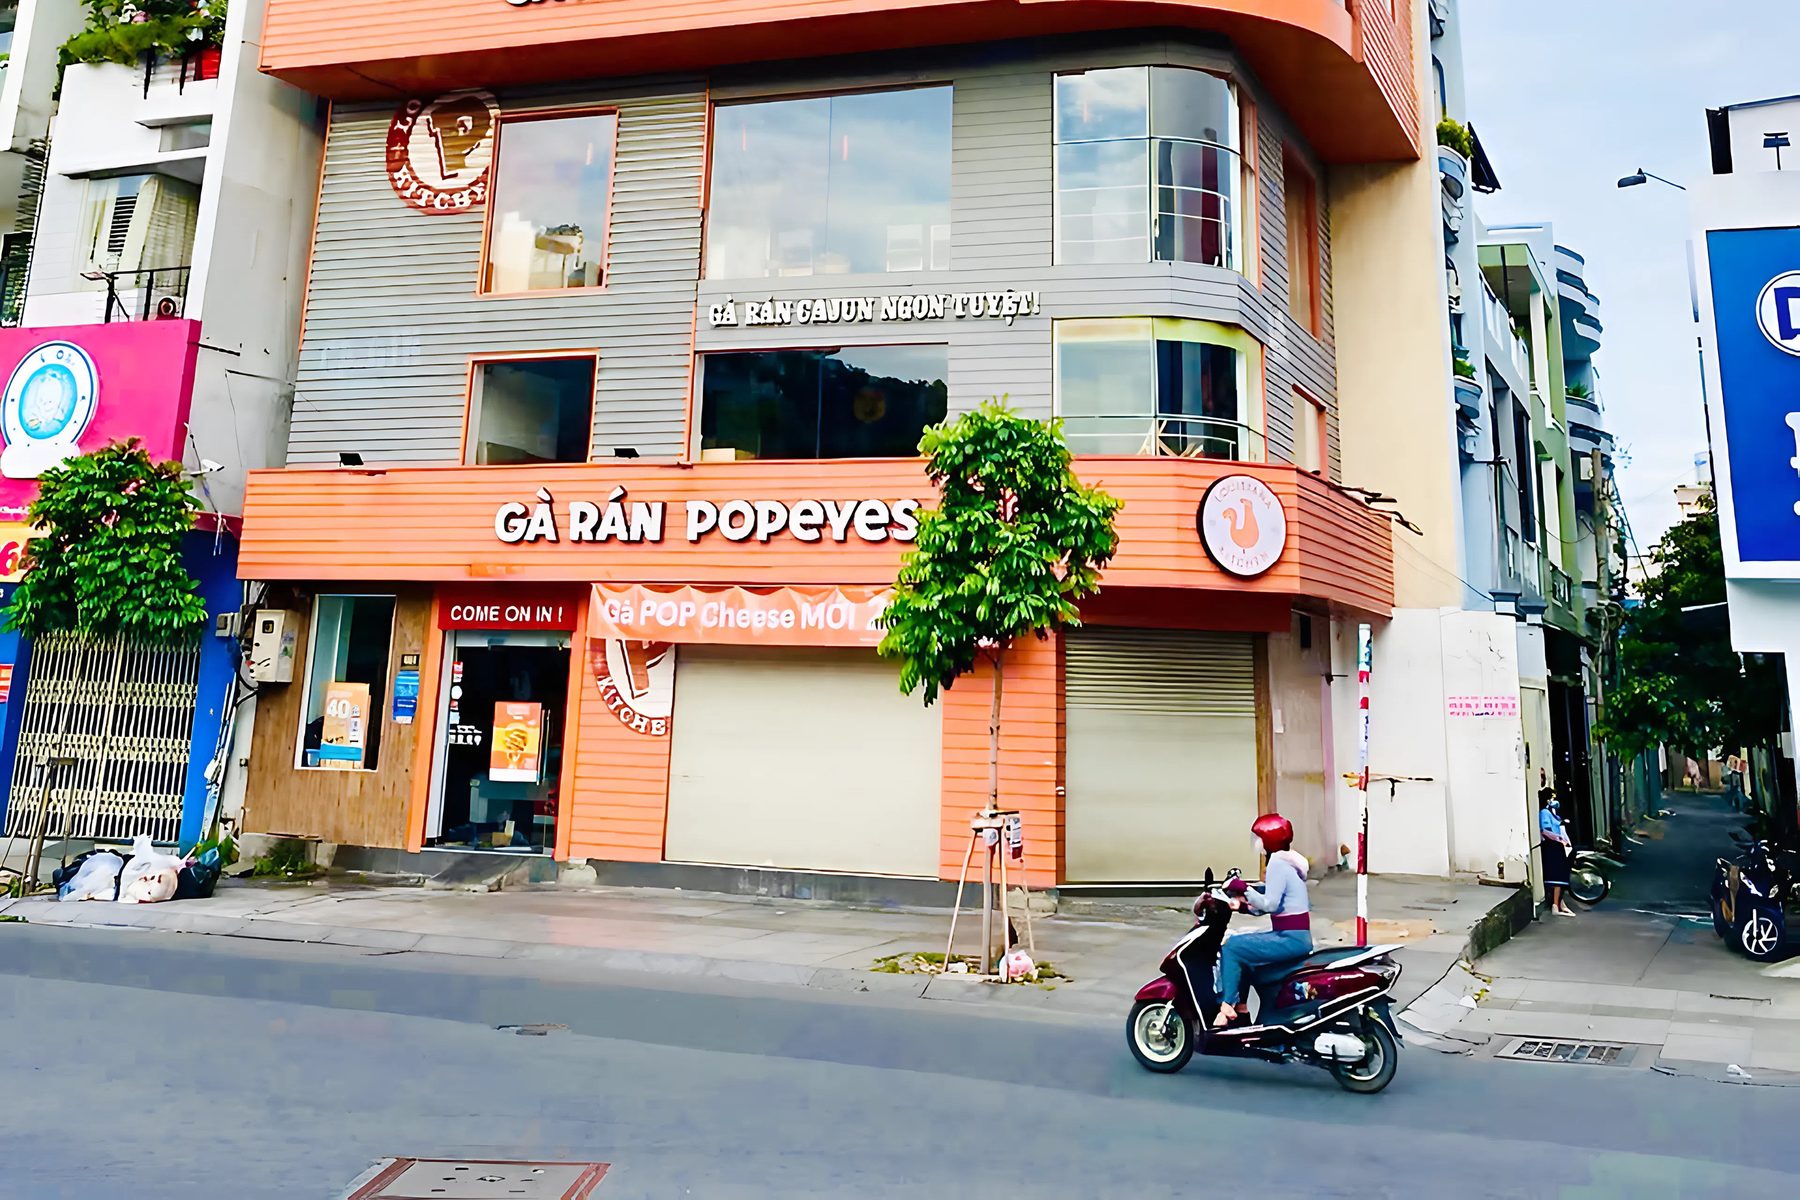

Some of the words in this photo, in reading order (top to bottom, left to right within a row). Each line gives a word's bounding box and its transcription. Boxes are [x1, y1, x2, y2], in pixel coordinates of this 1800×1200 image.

[708, 294, 739, 327] GÀ
[745, 295, 794, 326] RÁN
[796, 298, 875, 324] CAJUN
[880, 294, 949, 322] NGON
[494, 485, 561, 544] GÀ
[568, 484, 667, 544] RÁN
[450, 605, 500, 622] COME
[505, 605, 531, 622] ON
[536, 605, 552, 623] IN
[639, 599, 697, 627] POP
[702, 601, 795, 629] Cheese
[326, 699, 352, 719] 40
